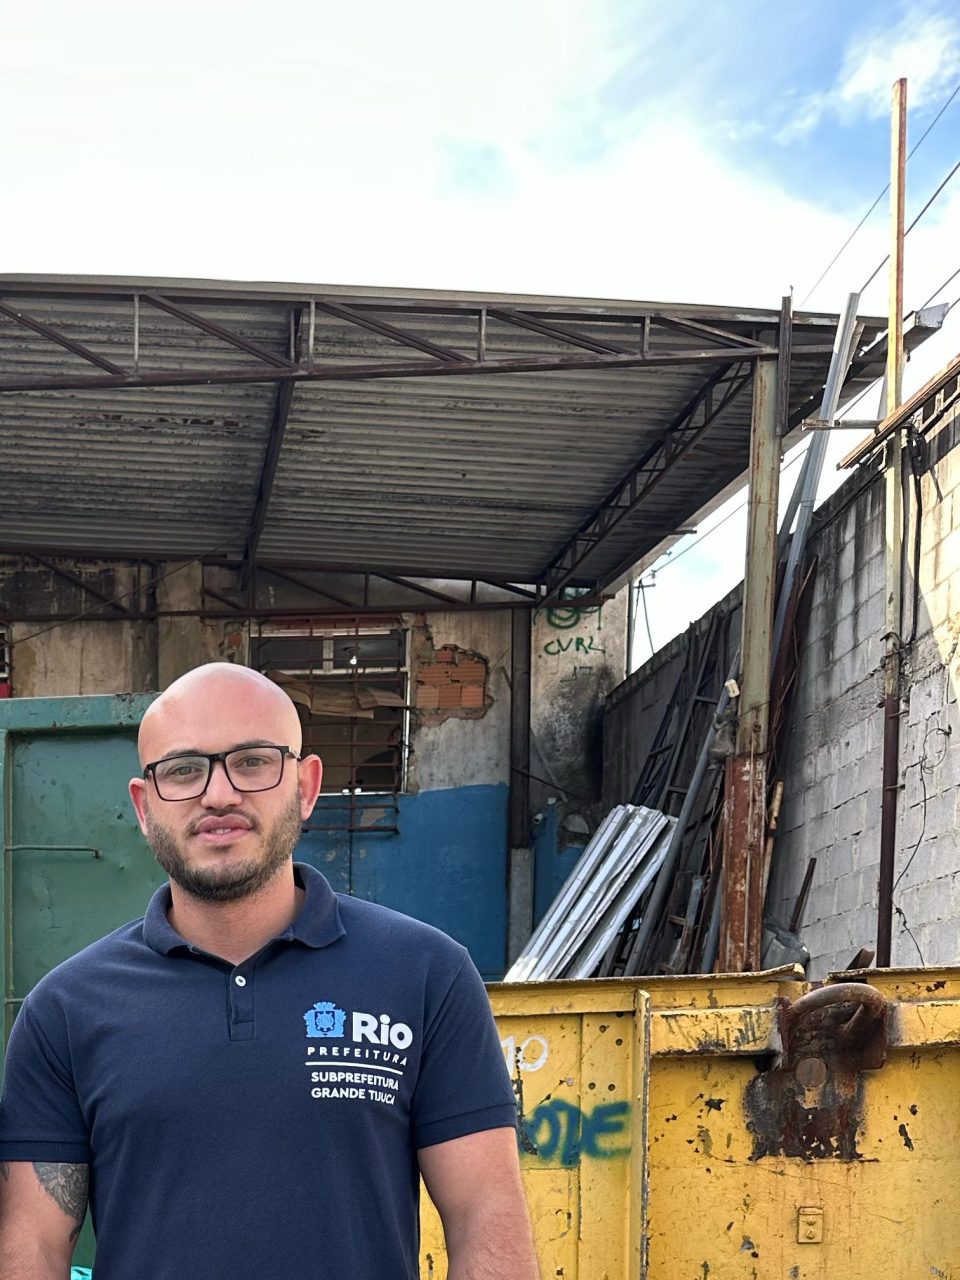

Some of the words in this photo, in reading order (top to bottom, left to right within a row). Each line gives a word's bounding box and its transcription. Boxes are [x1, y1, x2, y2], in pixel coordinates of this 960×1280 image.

[352, 1011, 413, 1050] Rio
[307, 1046, 408, 1066] PREFEITURA
[311, 1071, 399, 1091] SUBPREFEITURA
[311, 1087, 366, 1099] GRANDE
[368, 1089, 395, 1105] TIJUCA
